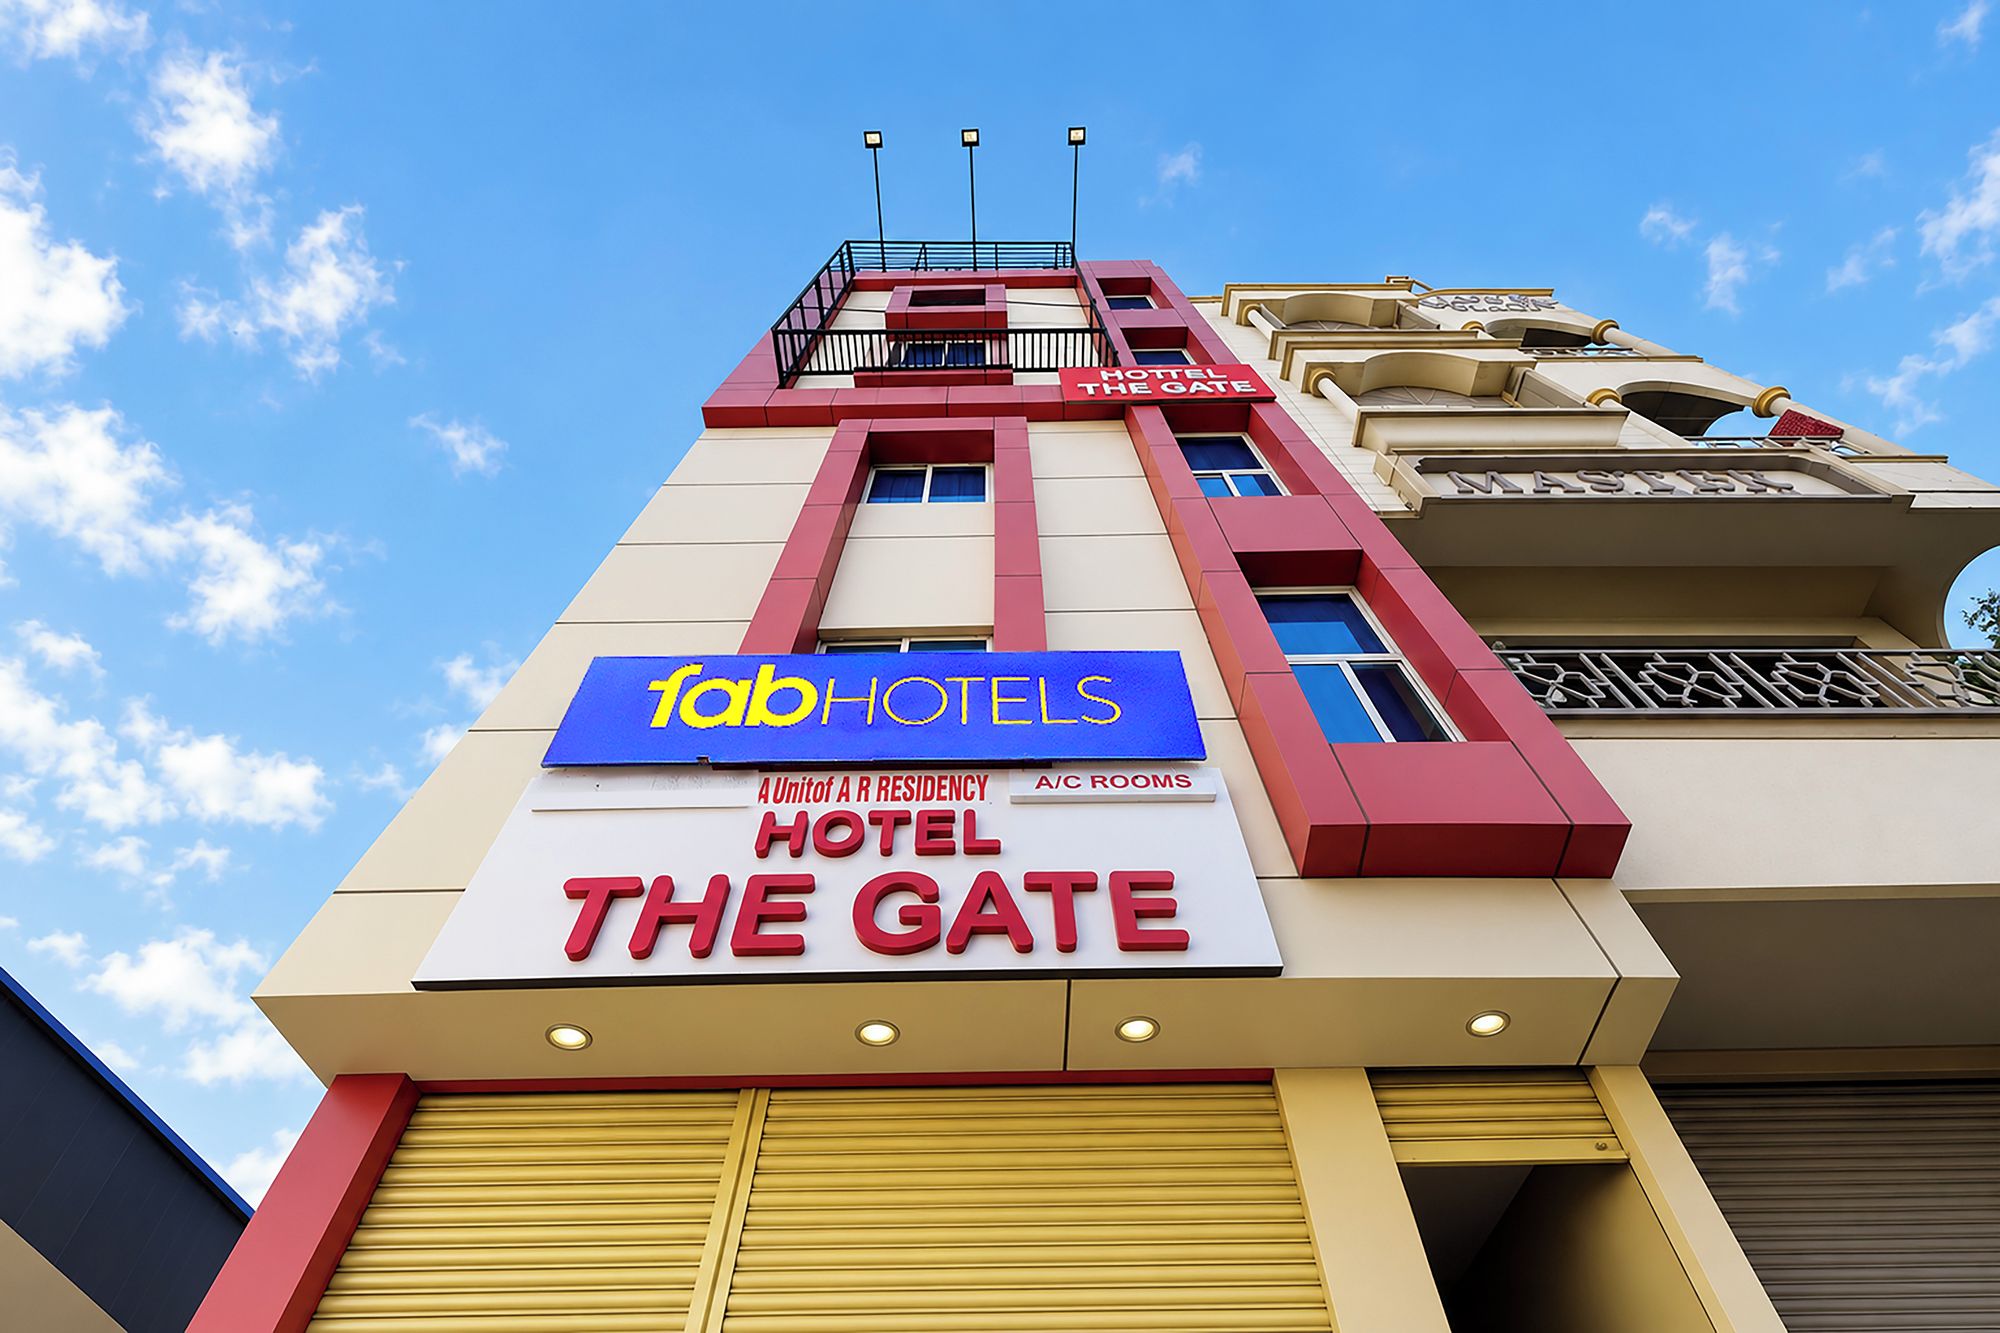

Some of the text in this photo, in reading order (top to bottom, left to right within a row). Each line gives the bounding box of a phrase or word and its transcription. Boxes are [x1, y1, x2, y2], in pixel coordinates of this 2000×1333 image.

[1077, 380, 1257, 396] THE GATE
[758, 776, 771, 804] A
[836, 775, 851, 803] A
[856, 775, 871, 802] R
[875, 774, 990, 802] RESIDENCY
[1035, 774, 1193, 789] A/C ROOMS
[754, 808, 1002, 859] HOTEL
[563, 869, 1191, 962] THE GATE
